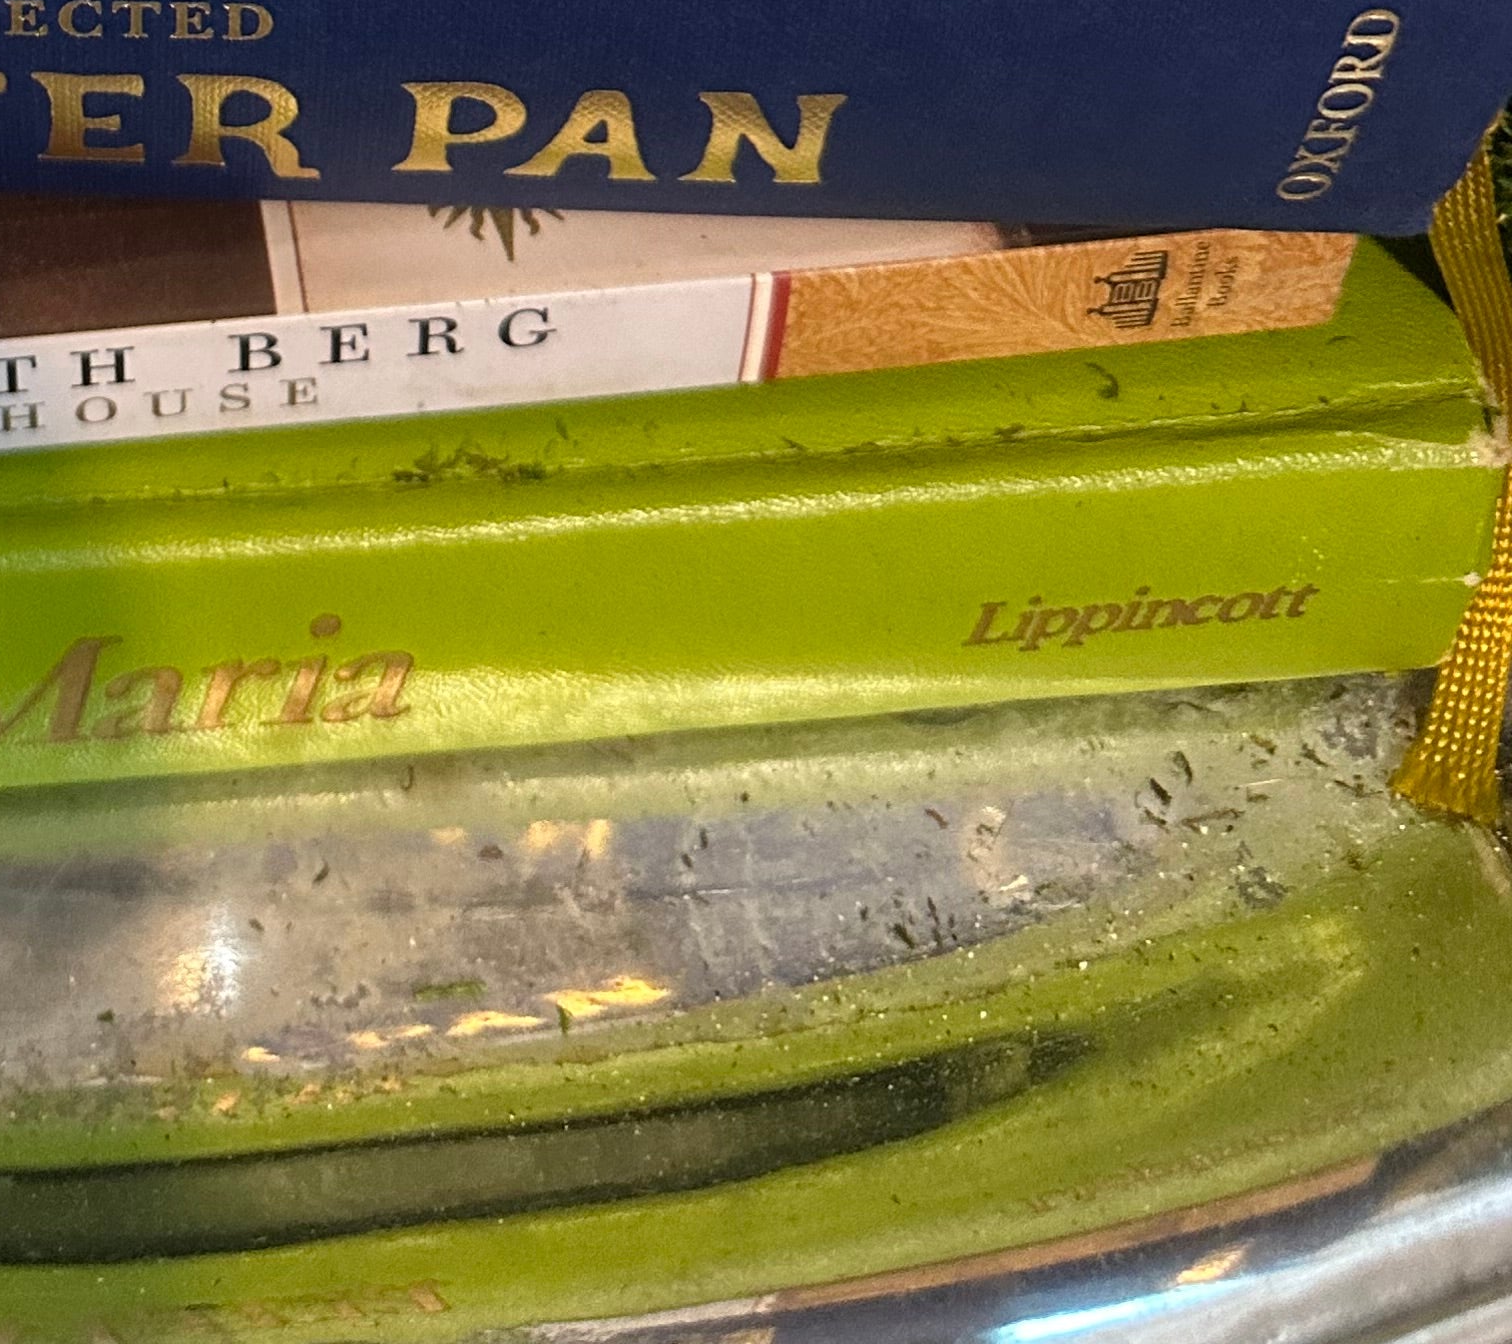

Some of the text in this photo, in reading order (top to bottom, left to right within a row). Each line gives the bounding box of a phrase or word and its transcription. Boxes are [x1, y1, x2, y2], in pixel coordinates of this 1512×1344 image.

[390, 80, 849, 184] PAN
[1275, 8, 1401, 201] OXFORD
[1169, 240, 1211, 328] Ballantine
[1206, 255, 1241, 307] Books
[228, 306, 558, 374] BERG
[959, 581, 1322, 653] Lippincott
